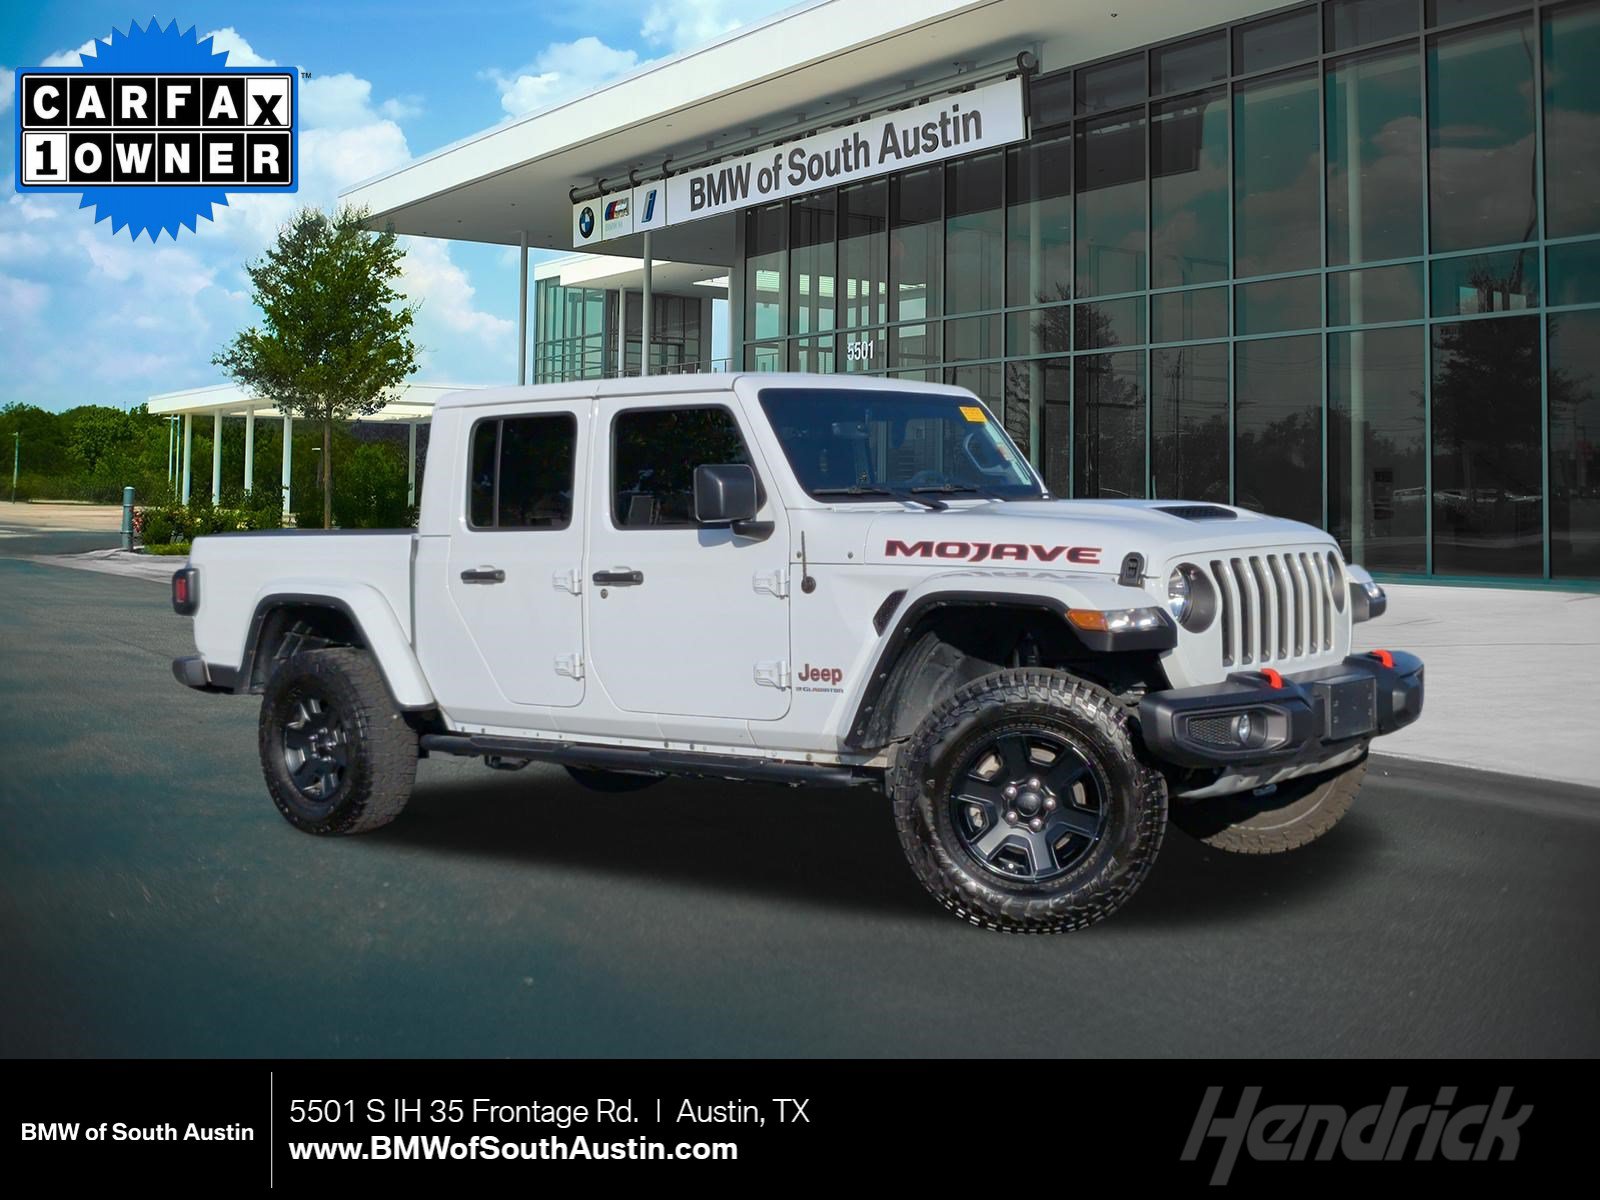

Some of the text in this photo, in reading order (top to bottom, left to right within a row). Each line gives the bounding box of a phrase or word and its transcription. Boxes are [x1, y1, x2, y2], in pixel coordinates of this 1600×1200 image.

[690, 162, 751, 212] BMW
[757, 153, 783, 194] of
[787, 132, 871, 186] South
[878, 104, 983, 164] Austin
[847, 340, 874, 361] 5501
[884, 539, 1102, 564] MOJAVE
[798, 663, 843, 686] Jeep
